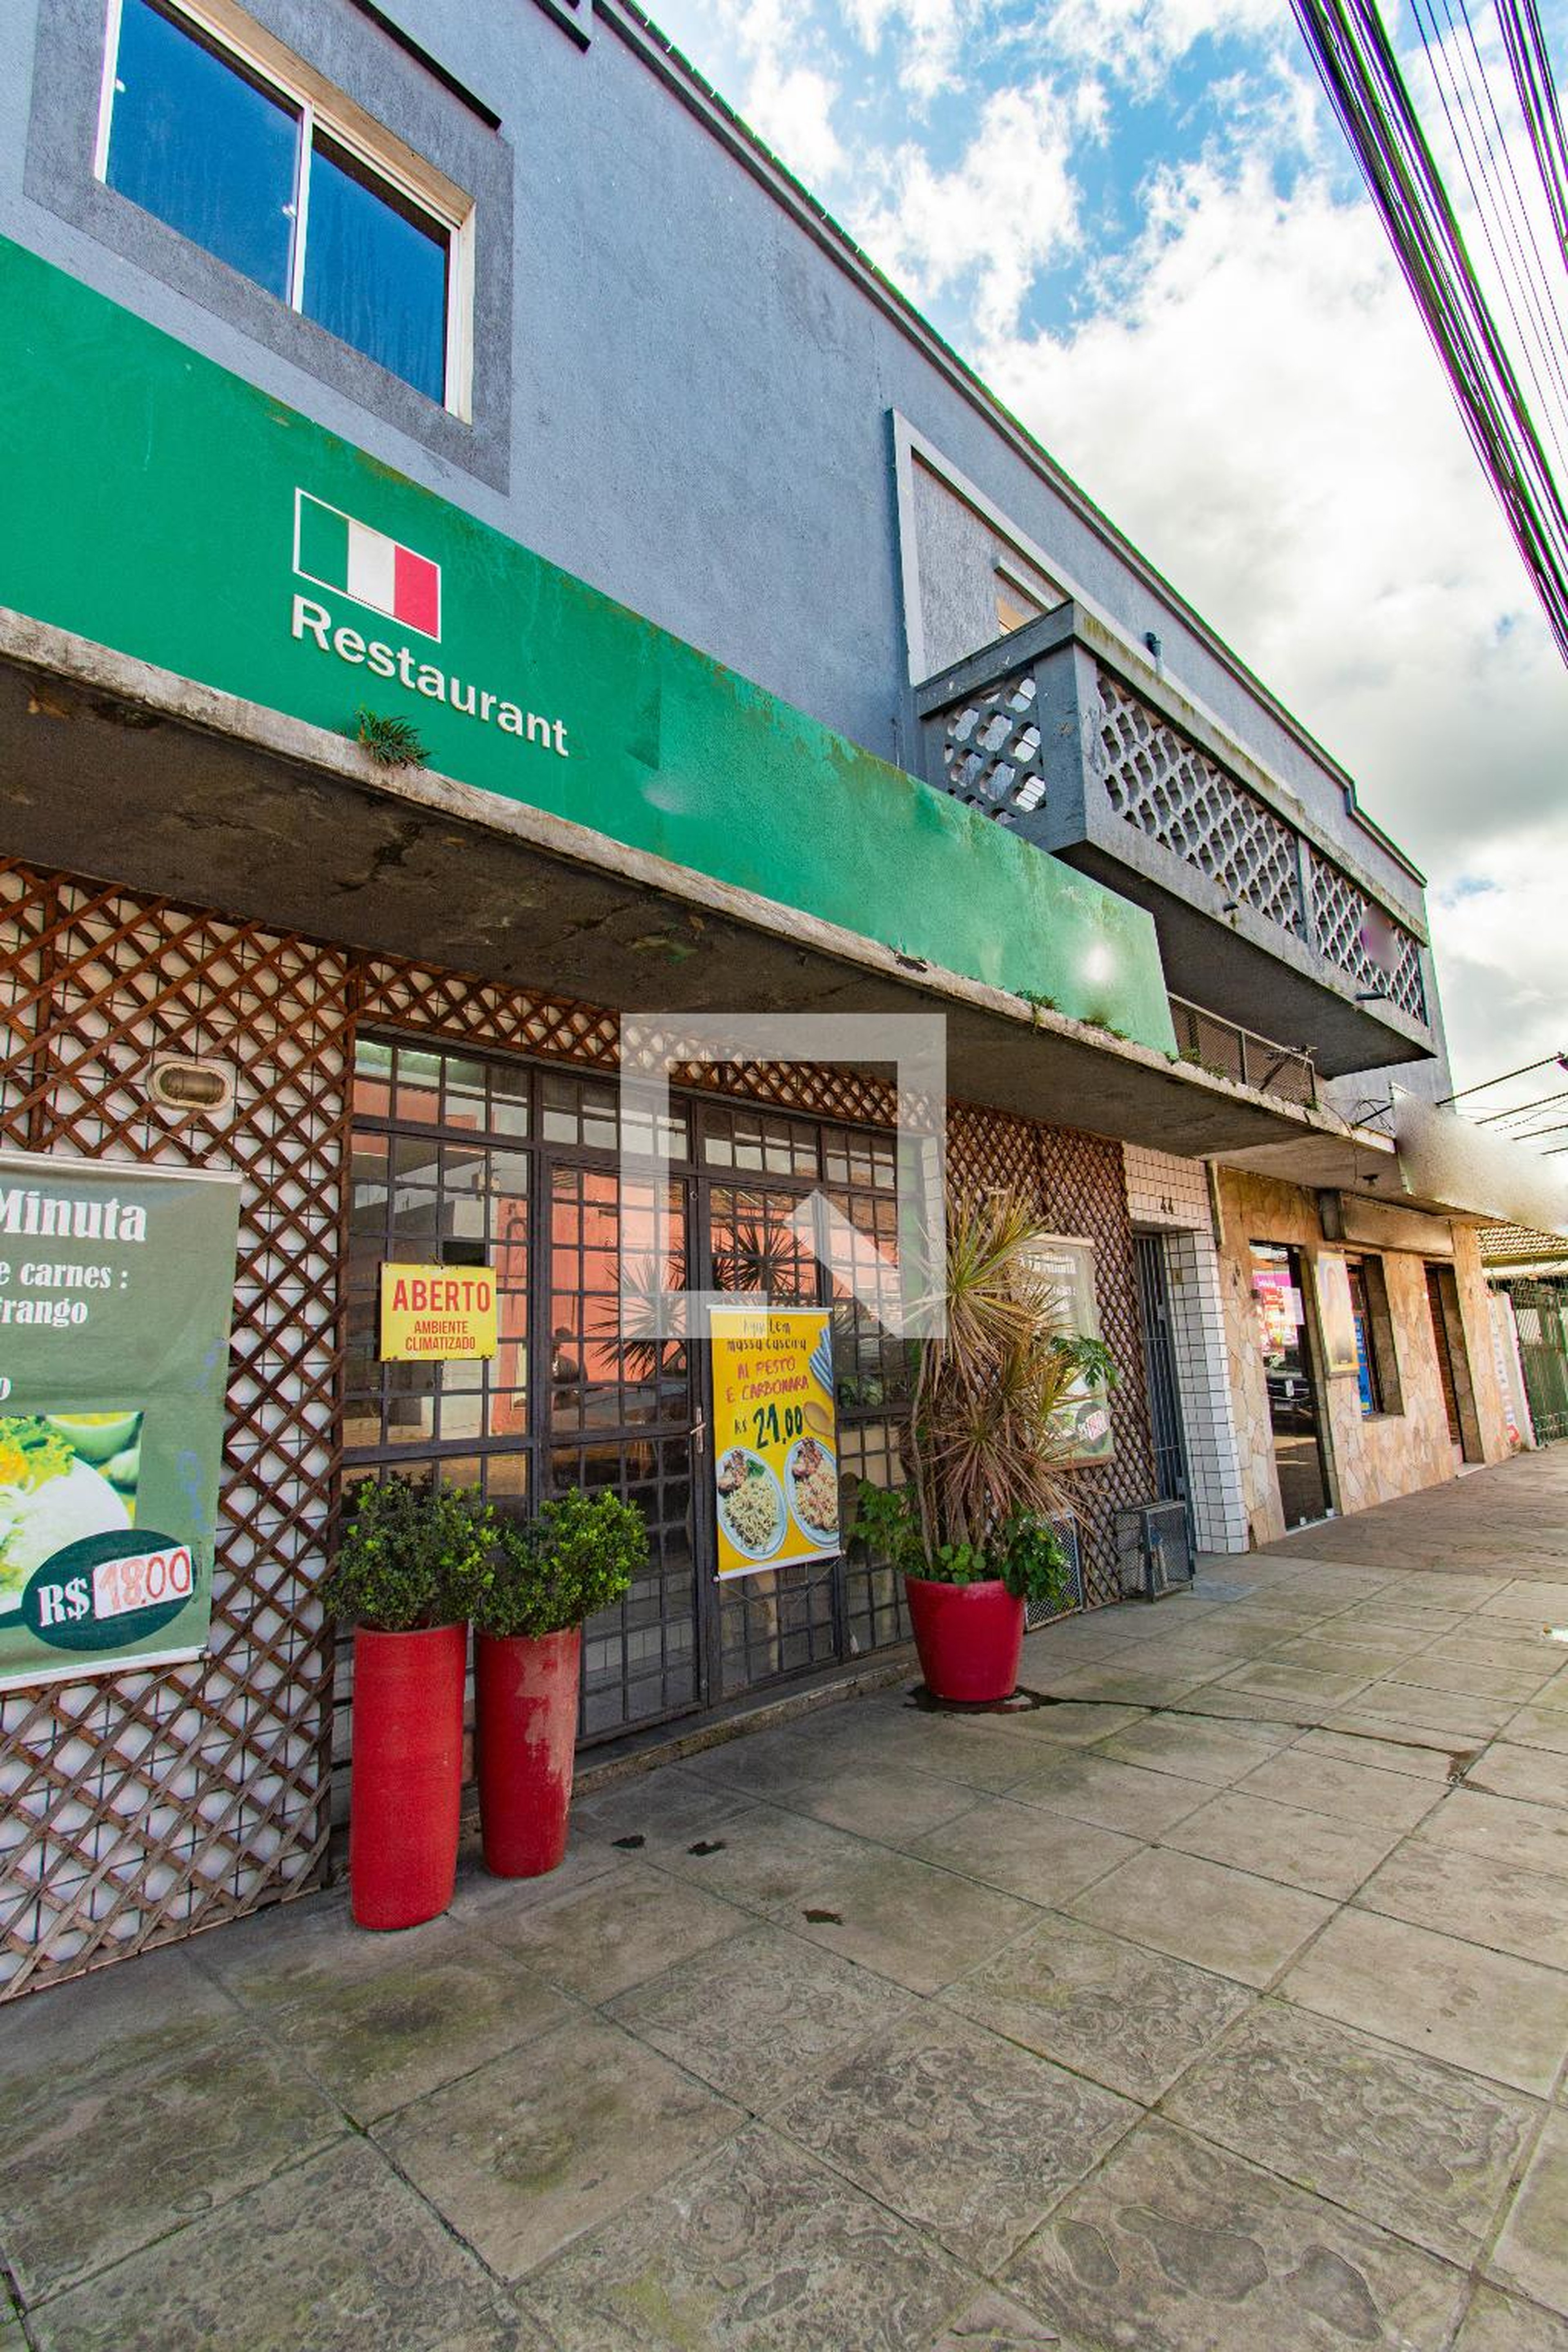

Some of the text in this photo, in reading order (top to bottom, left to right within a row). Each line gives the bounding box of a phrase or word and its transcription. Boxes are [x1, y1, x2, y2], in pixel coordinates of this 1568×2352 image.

[292, 594, 569, 757] Restaurant
[392, 1279, 491, 1312] ABERTO
[0, 1296, 87, 1327] rango
[414, 1321, 468, 1334] AMBIENTE
[405, 1336, 475, 1351] CLIMATIZADO
[742, 1375, 809, 1401] CARBONARA
[38, 1577, 91, 1627] R$
